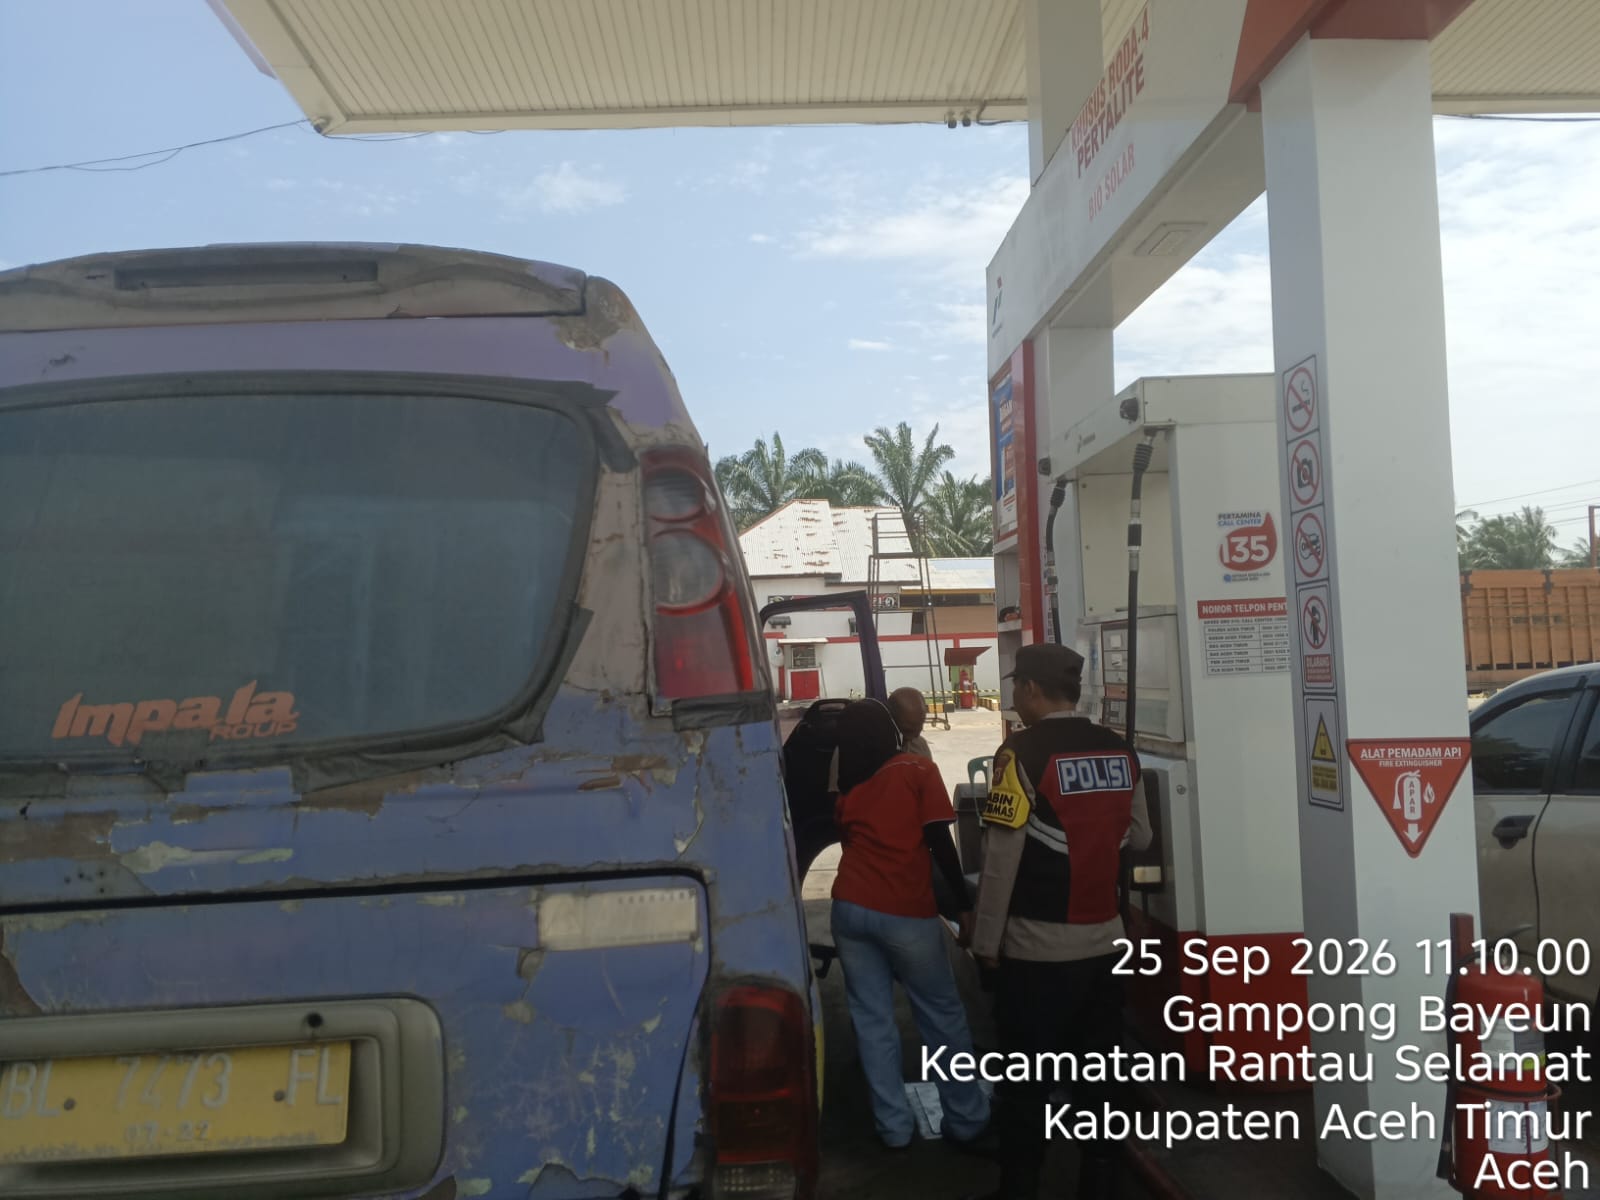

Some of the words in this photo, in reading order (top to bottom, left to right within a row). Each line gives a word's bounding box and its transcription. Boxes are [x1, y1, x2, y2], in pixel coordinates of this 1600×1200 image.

[1070, 77, 1106, 154] KHUSUS
[1077, 54, 1145, 179] PERTALITE
[1088, 187, 1103, 222] BIO
[1105, 143, 1136, 201] SOLAR
[1218, 512, 1261, 520] PERTAMINA
[1222, 535, 1270, 564] 135
[1202, 604, 1232, 614] NOMOR
[1234, 603, 1266, 614] TELPON
[1360, 748, 1386, 758] ALAT
[1388, 748, 1442, 758] PEMADAM
[1444, 747, 1462, 758] API
[1061, 758, 1130, 792] POLISI
[2, 1061, 60, 1119] BL
[114, 1052, 234, 1110] 7473
[285, 1048, 342, 1106] FL
